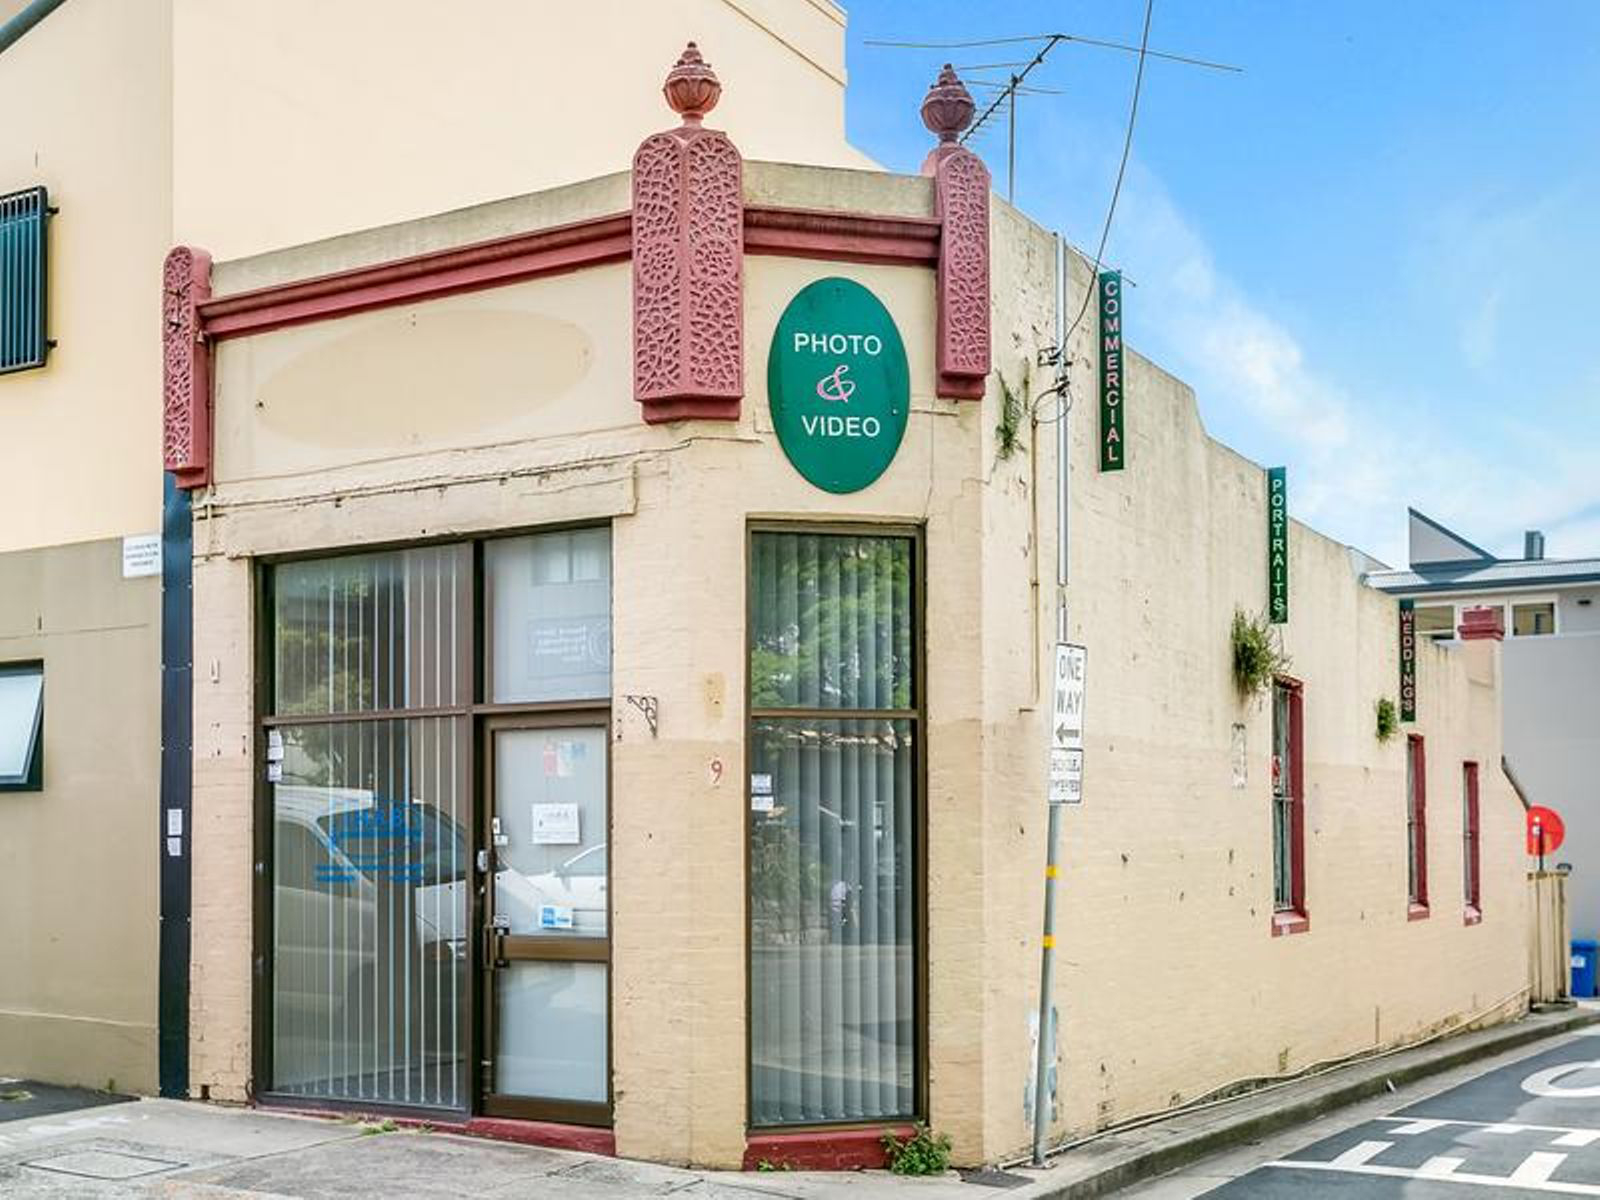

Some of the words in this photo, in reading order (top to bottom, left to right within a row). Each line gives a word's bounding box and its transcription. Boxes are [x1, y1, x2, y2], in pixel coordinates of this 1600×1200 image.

[793, 332, 882, 356] PHOTO
[816, 364, 856, 403] &
[1104, 280, 1121, 462] COMMERCIAL
[801, 415, 881, 438] VIDEO
[1271, 478, 1285, 610] PORTRAITS
[1059, 654, 1083, 681] ONE
[1401, 610, 1414, 712] WEDDINGS
[1057, 689, 1083, 715] WAY
[711, 760, 723, 785] 9
